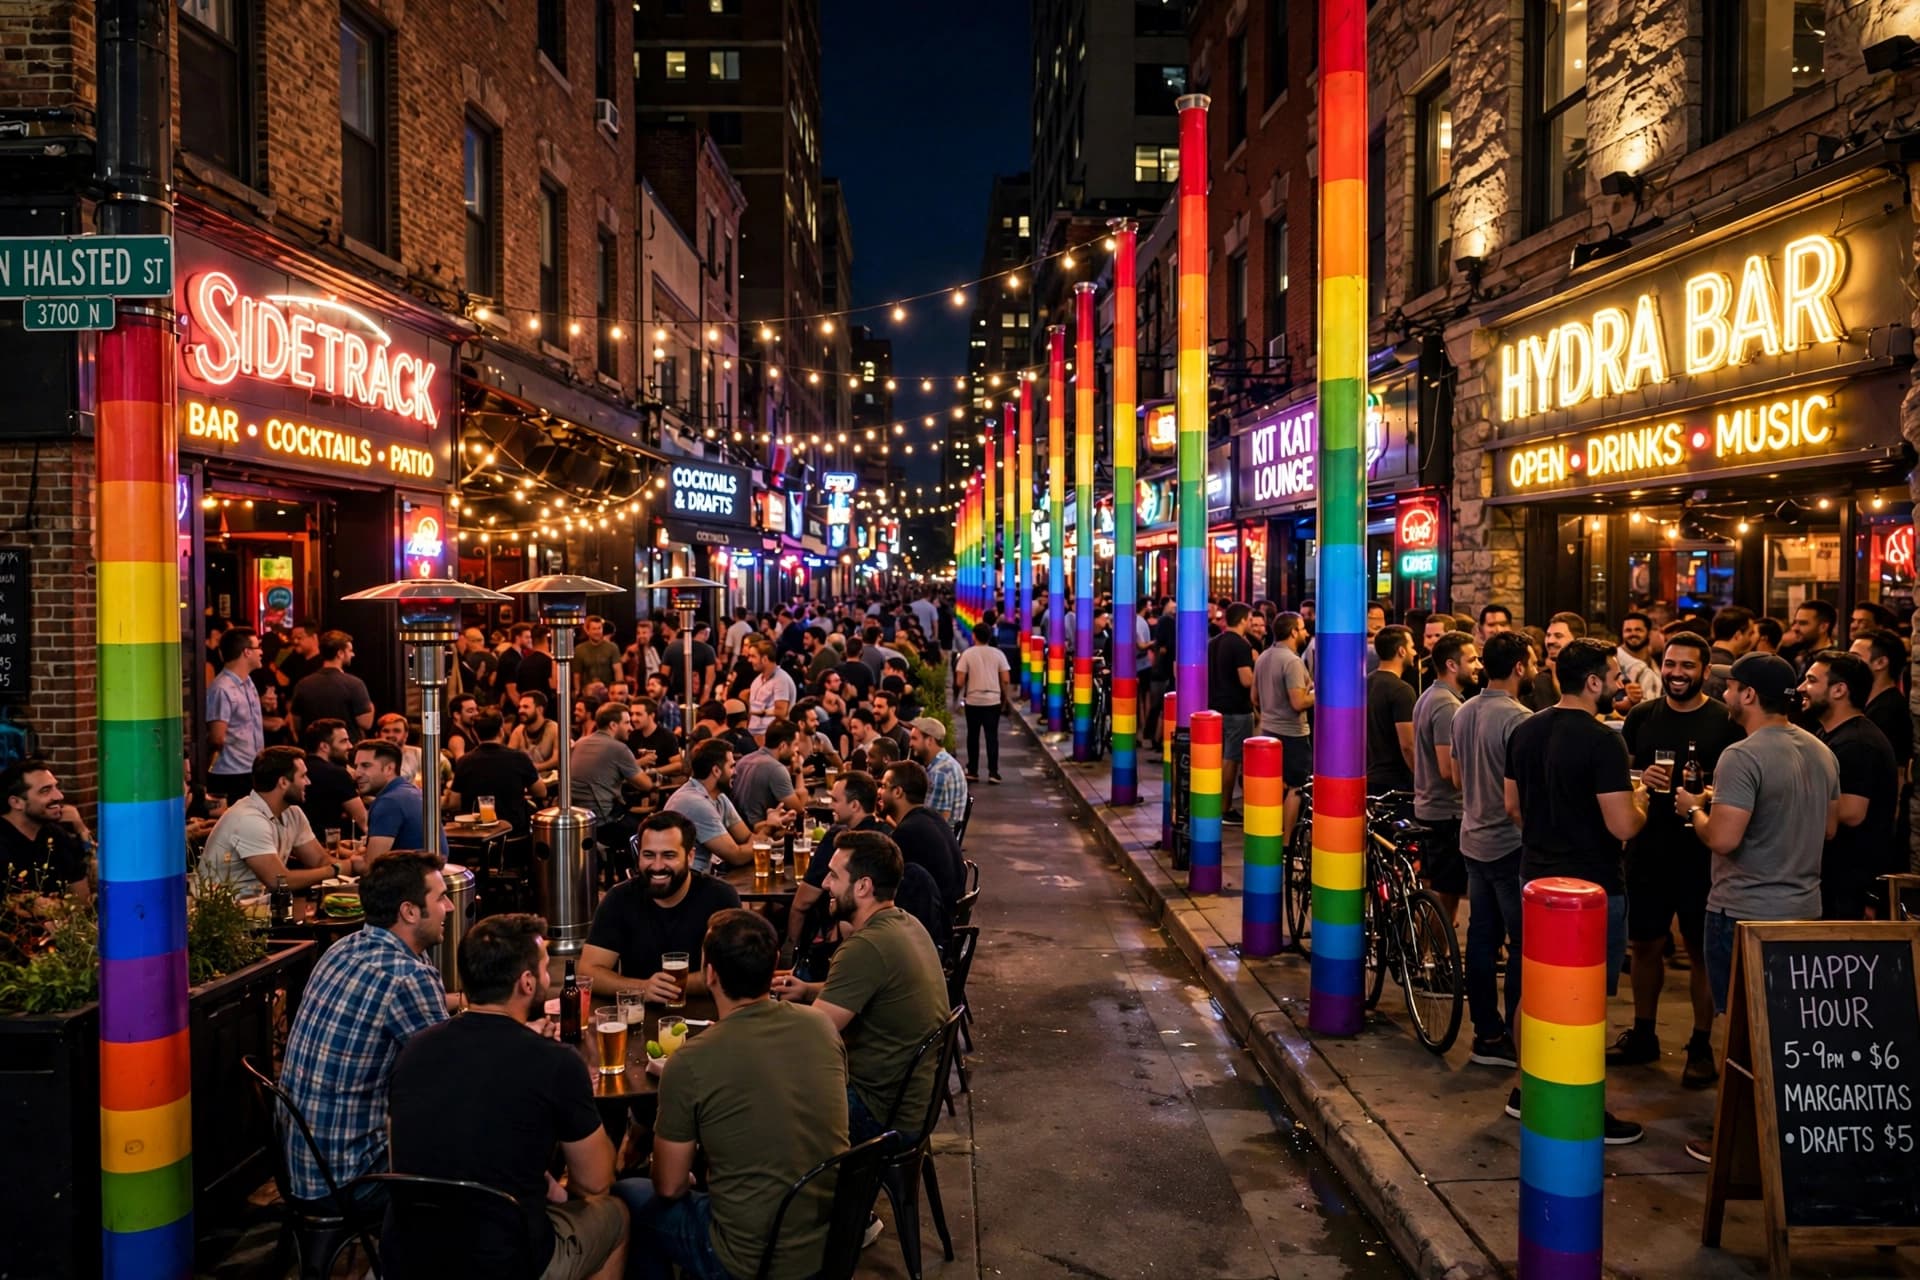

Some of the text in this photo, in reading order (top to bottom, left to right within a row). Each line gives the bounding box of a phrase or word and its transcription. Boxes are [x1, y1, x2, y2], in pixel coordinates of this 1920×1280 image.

[0, 248, 163, 287] N HALSTED ST
[38, 303, 100, 325] 3700 N
[1501, 234, 1846, 423] HYDRA BAR
[194, 271, 438, 426] SIDETRACK
[188, 402, 434, 478] BAR COCKTAILS PATIO
[1252, 412, 1314, 466] KIT KAT
[1510, 394, 1829, 488] OPEN DRINKS MUSIC
[672, 466, 737, 495] COCKTAILS
[1254, 456, 1314, 500] LOUNGE
[674, 490, 733, 515] & DRAFTS
[1789, 954, 1879, 990] HAPPY
[1799, 996, 1874, 1029] HOUR
[1869, 1041, 1900, 1070] $6
[1784, 1083, 1912, 1112] MARGARITAS
[1799, 1123, 1914, 1154] DRAFTS $5
